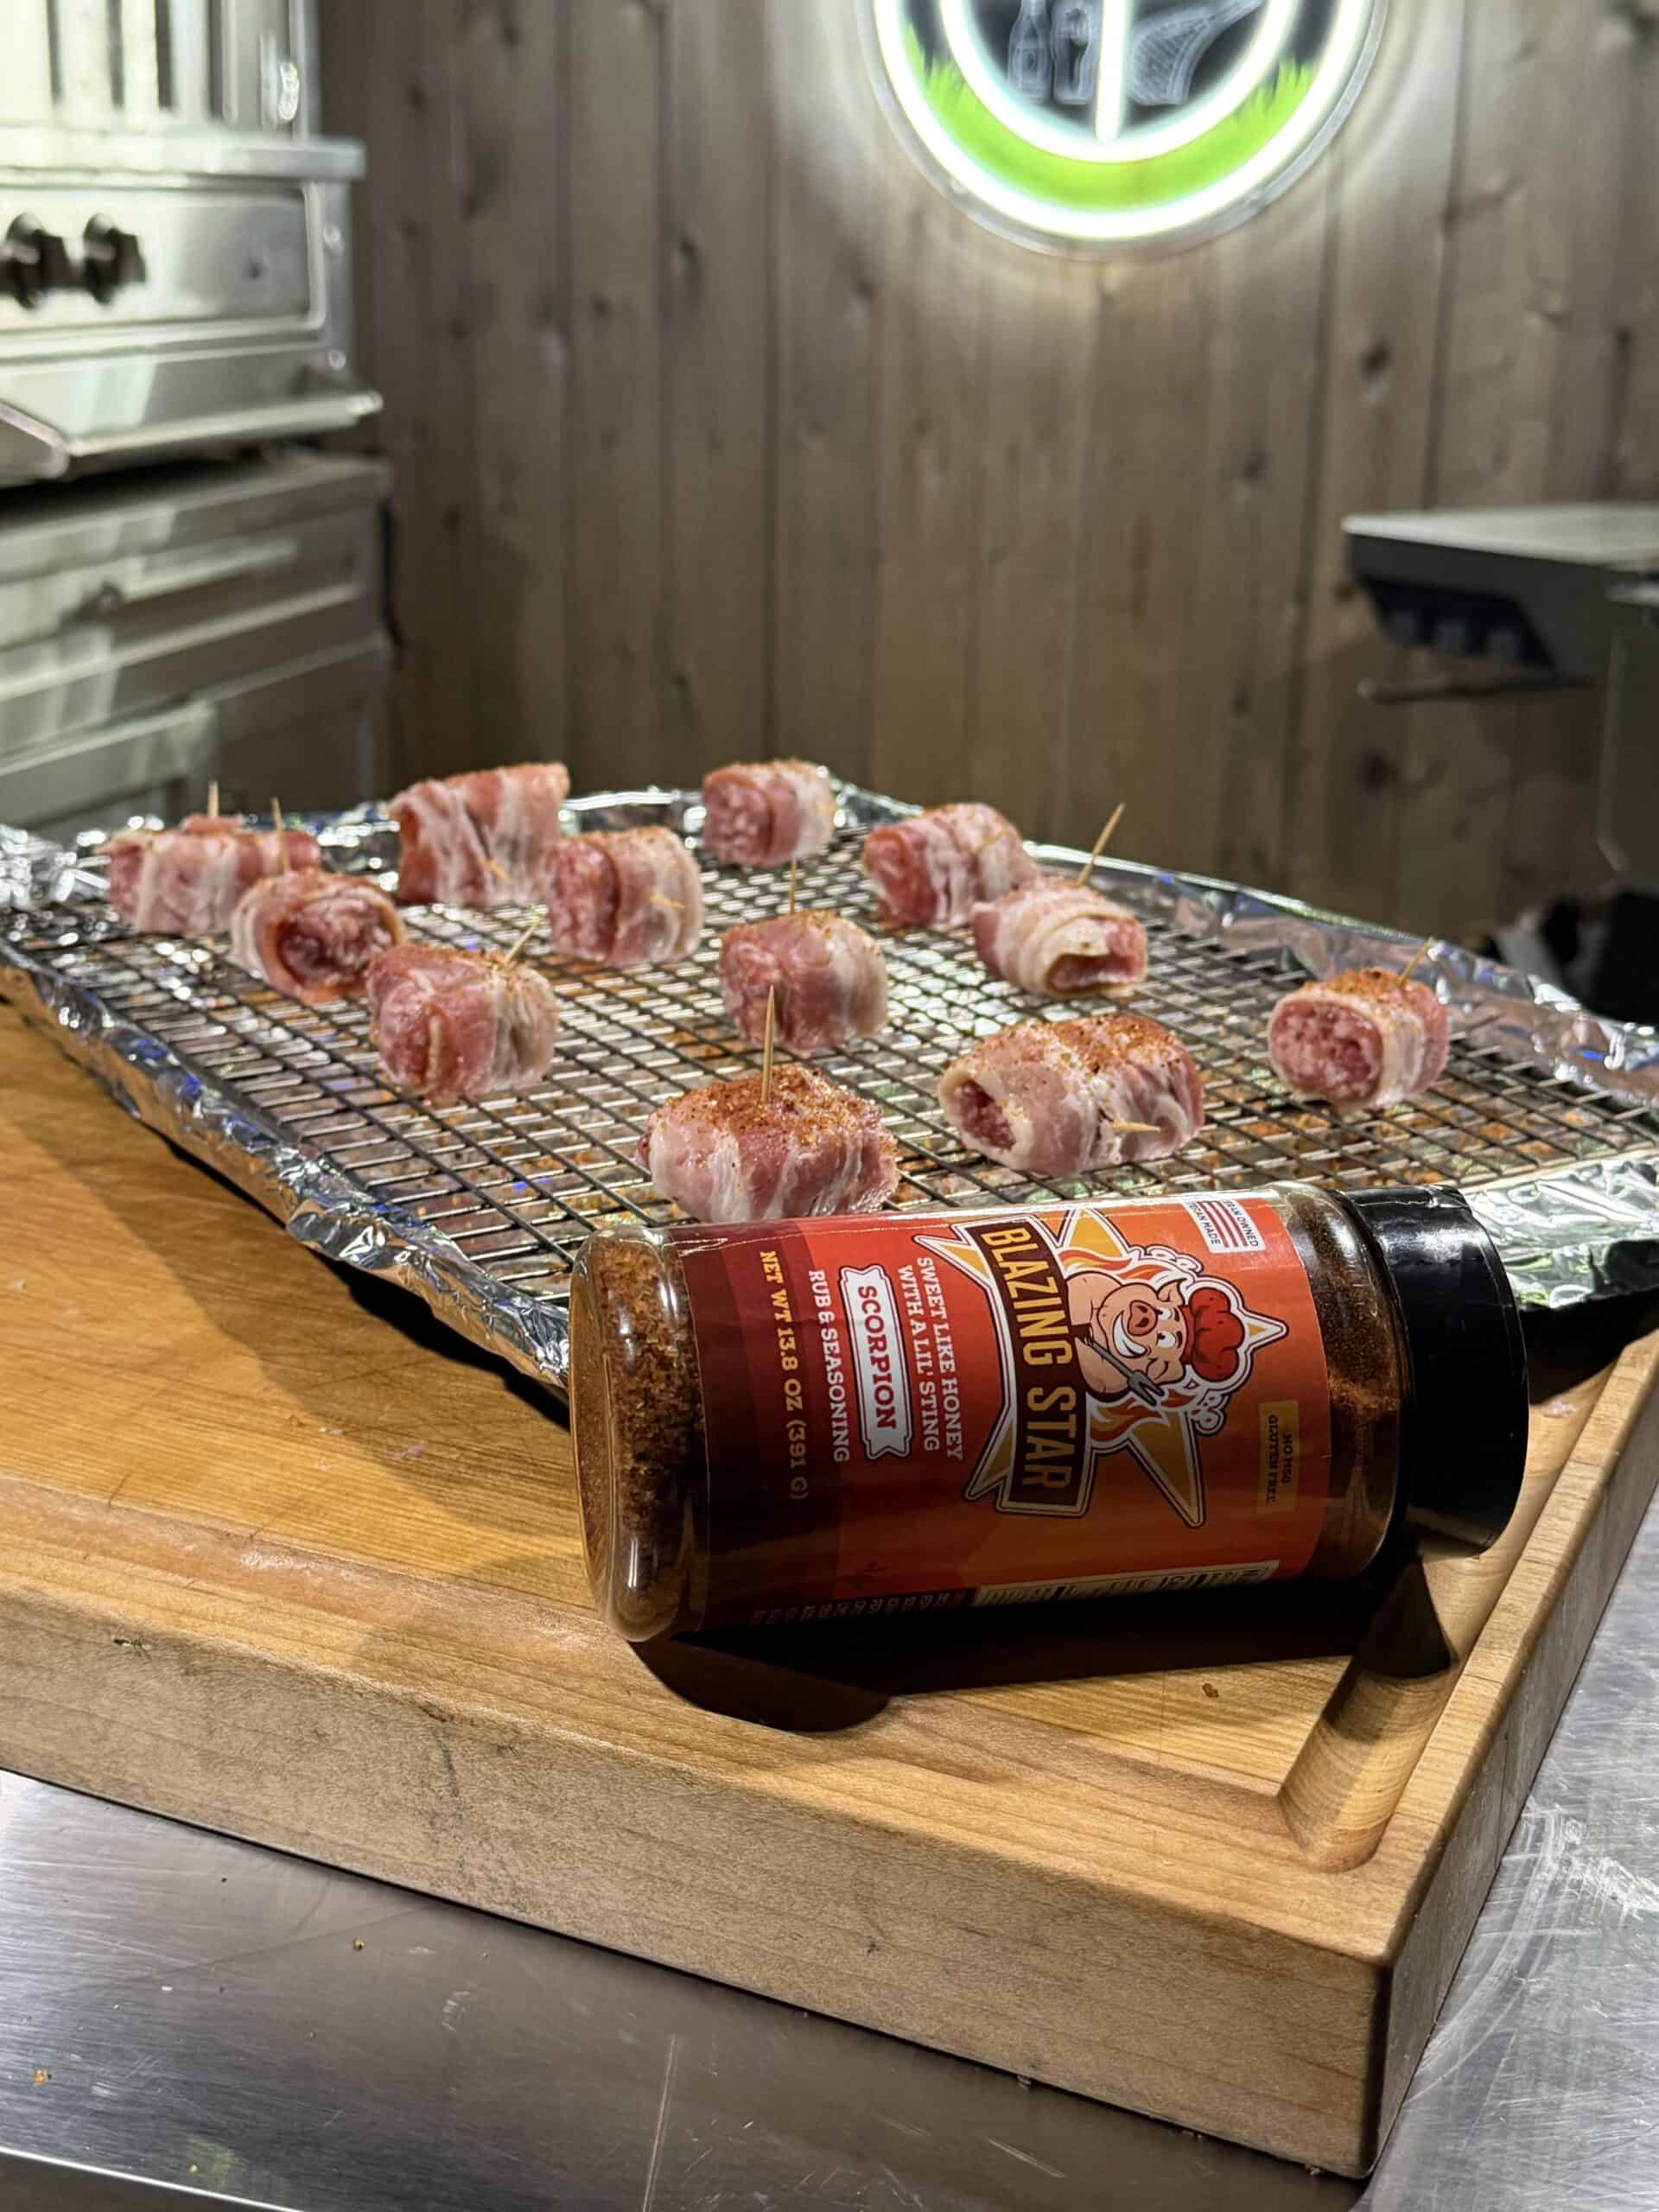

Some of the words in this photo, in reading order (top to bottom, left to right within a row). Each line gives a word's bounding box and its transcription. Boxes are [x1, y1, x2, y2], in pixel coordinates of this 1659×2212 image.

[1202, 1221, 1221, 1245] MADE
[1236, 1216, 1259, 1247] OWNED
[760, 1250, 784, 1284] NET
[808, 1269, 832, 1307] RUB
[917, 1257, 948, 1319] SWEET
[771, 1288, 792, 1323] WT
[899, 1264, 925, 1315] WITH
[981, 1227, 1073, 1365] BLAZING
[817, 1311, 836, 1325] &
[910, 1319, 927, 1336] A
[777, 1328, 798, 1370] 13.8
[858, 1286, 896, 1429] SCORPION
[913, 1338, 934, 1376] LIL'
[933, 1322, 956, 1373] LIKE
[784, 1378, 804, 1411] OZ
[821, 1328, 850, 1462] SEASONING
[918, 1381, 940, 1451] STING
[941, 1377, 963, 1460] HONEY
[785, 1420, 807, 1468] (391
[1022, 1386, 1077, 1489] STAR
[790, 1476, 809, 1499] G)
